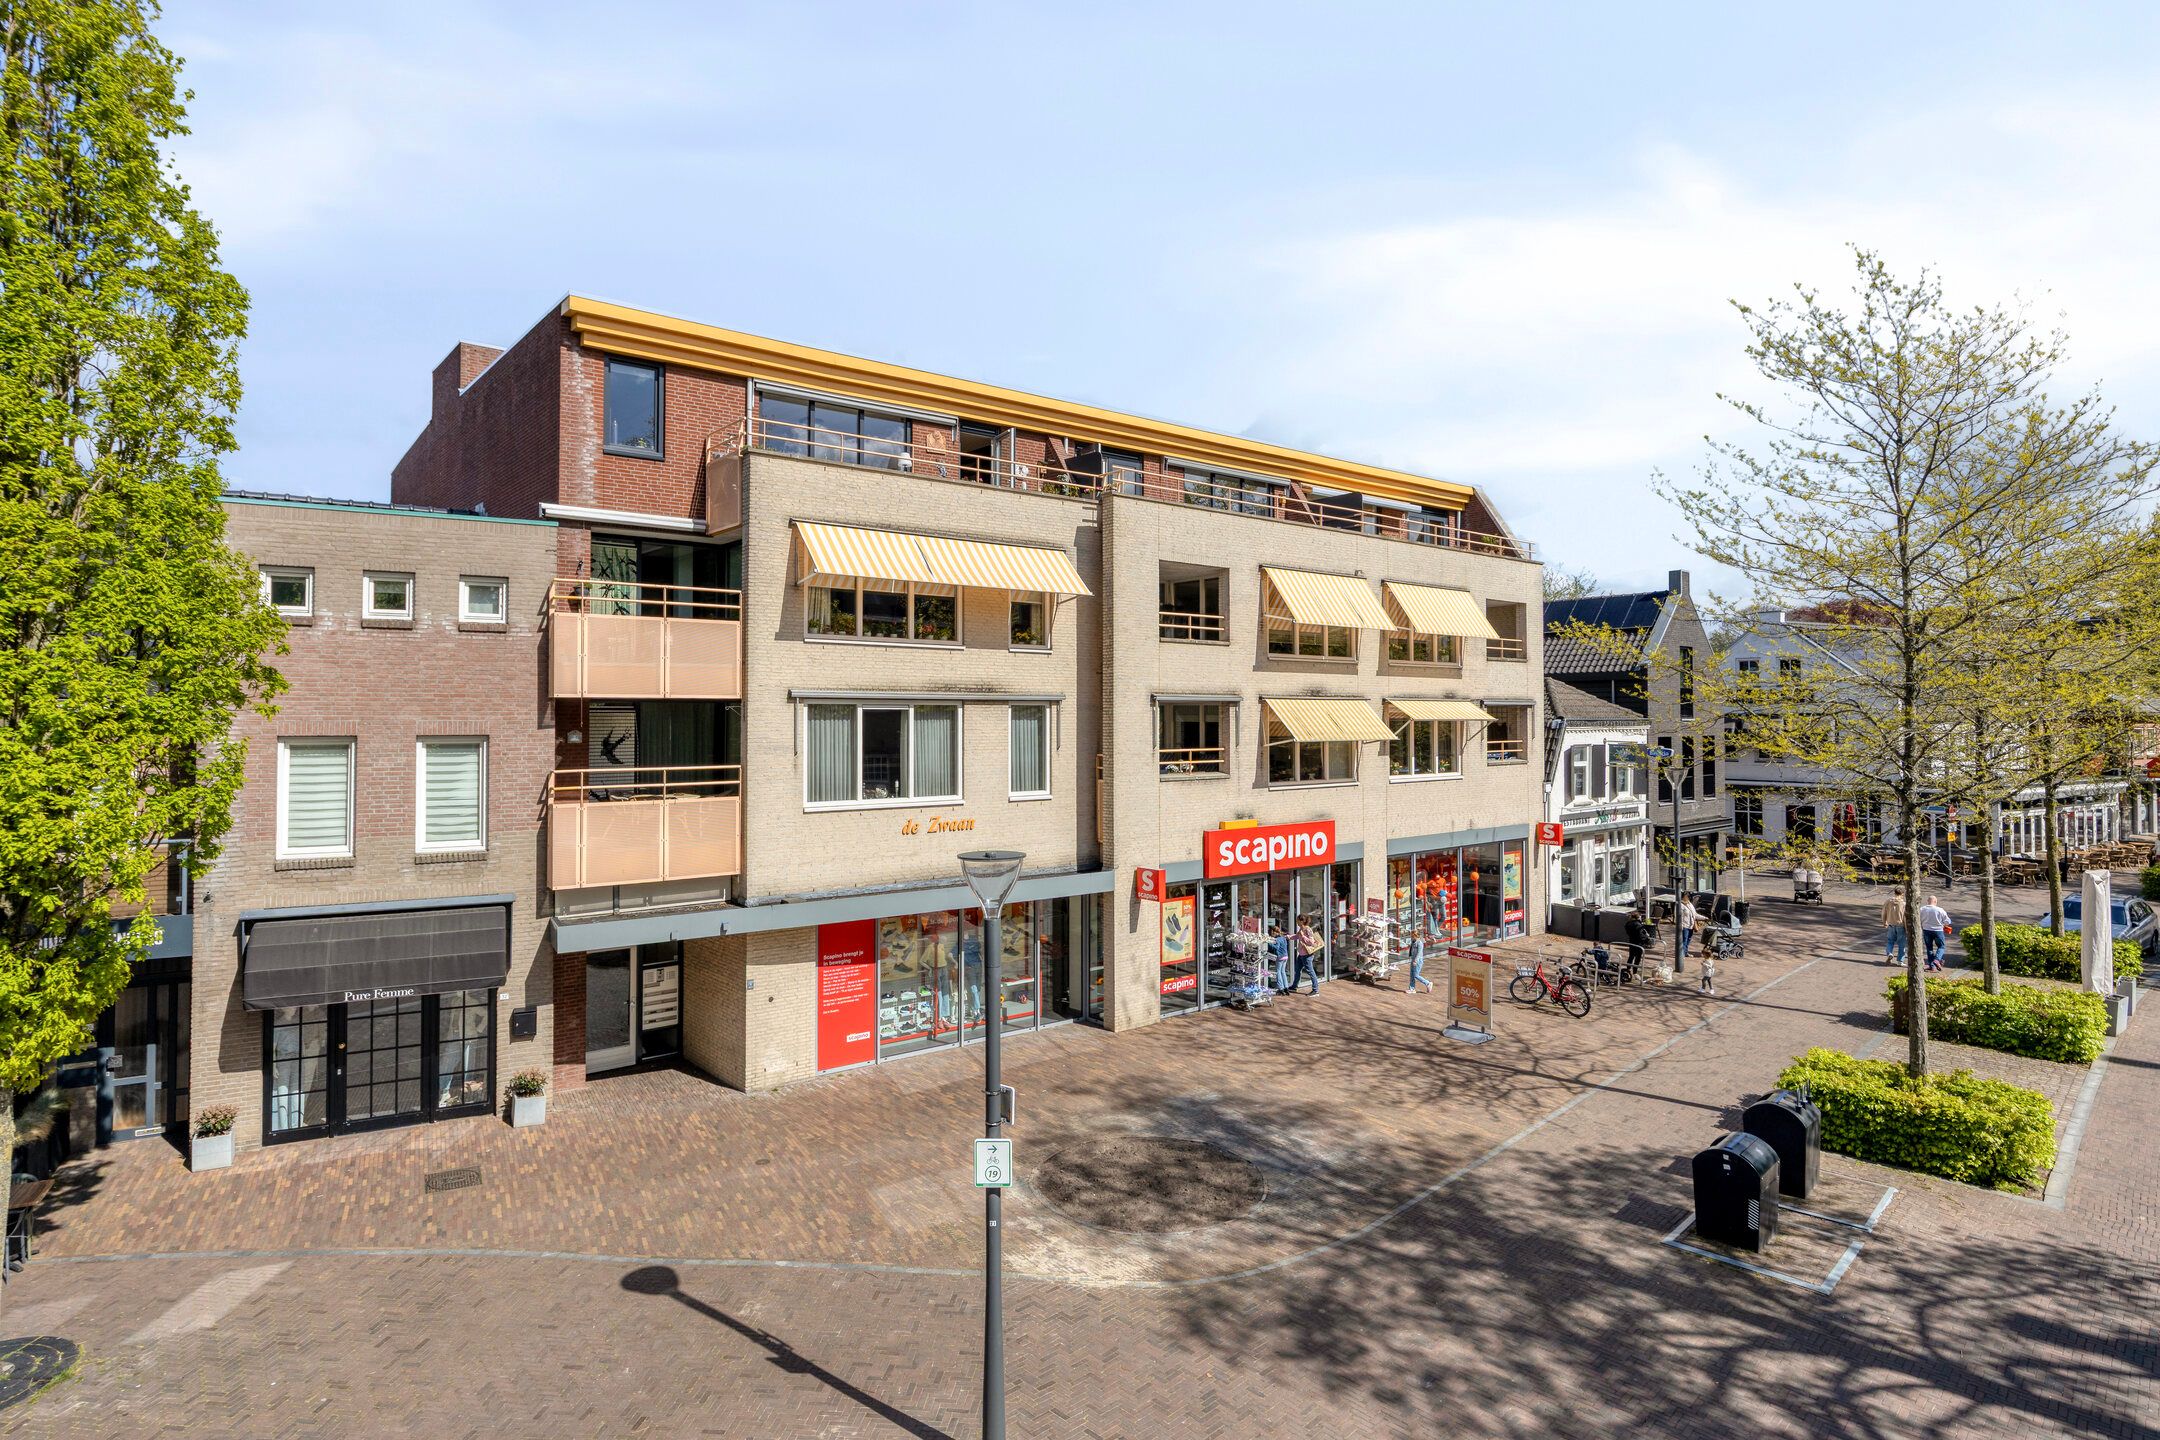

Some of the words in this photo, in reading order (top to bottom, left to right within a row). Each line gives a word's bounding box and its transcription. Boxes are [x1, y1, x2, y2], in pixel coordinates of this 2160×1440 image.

[901, 818, 919, 836] de
[927, 815, 977, 833] Zwaan
[1543, 824, 1555, 839] S
[1219, 831, 1328, 871] scapino
[1141, 870, 1154, 891] S
[1138, 892, 1158, 900] scapino
[829, 958, 851, 966] beweging
[1456, 951, 1482, 960] scapino
[1163, 978, 1194, 992] scapino
[344, 992, 371, 1001] Pure
[374, 988, 415, 999] Femme
[1460, 986, 1480, 999] 50%
[988, 1170, 999, 1178] 19
